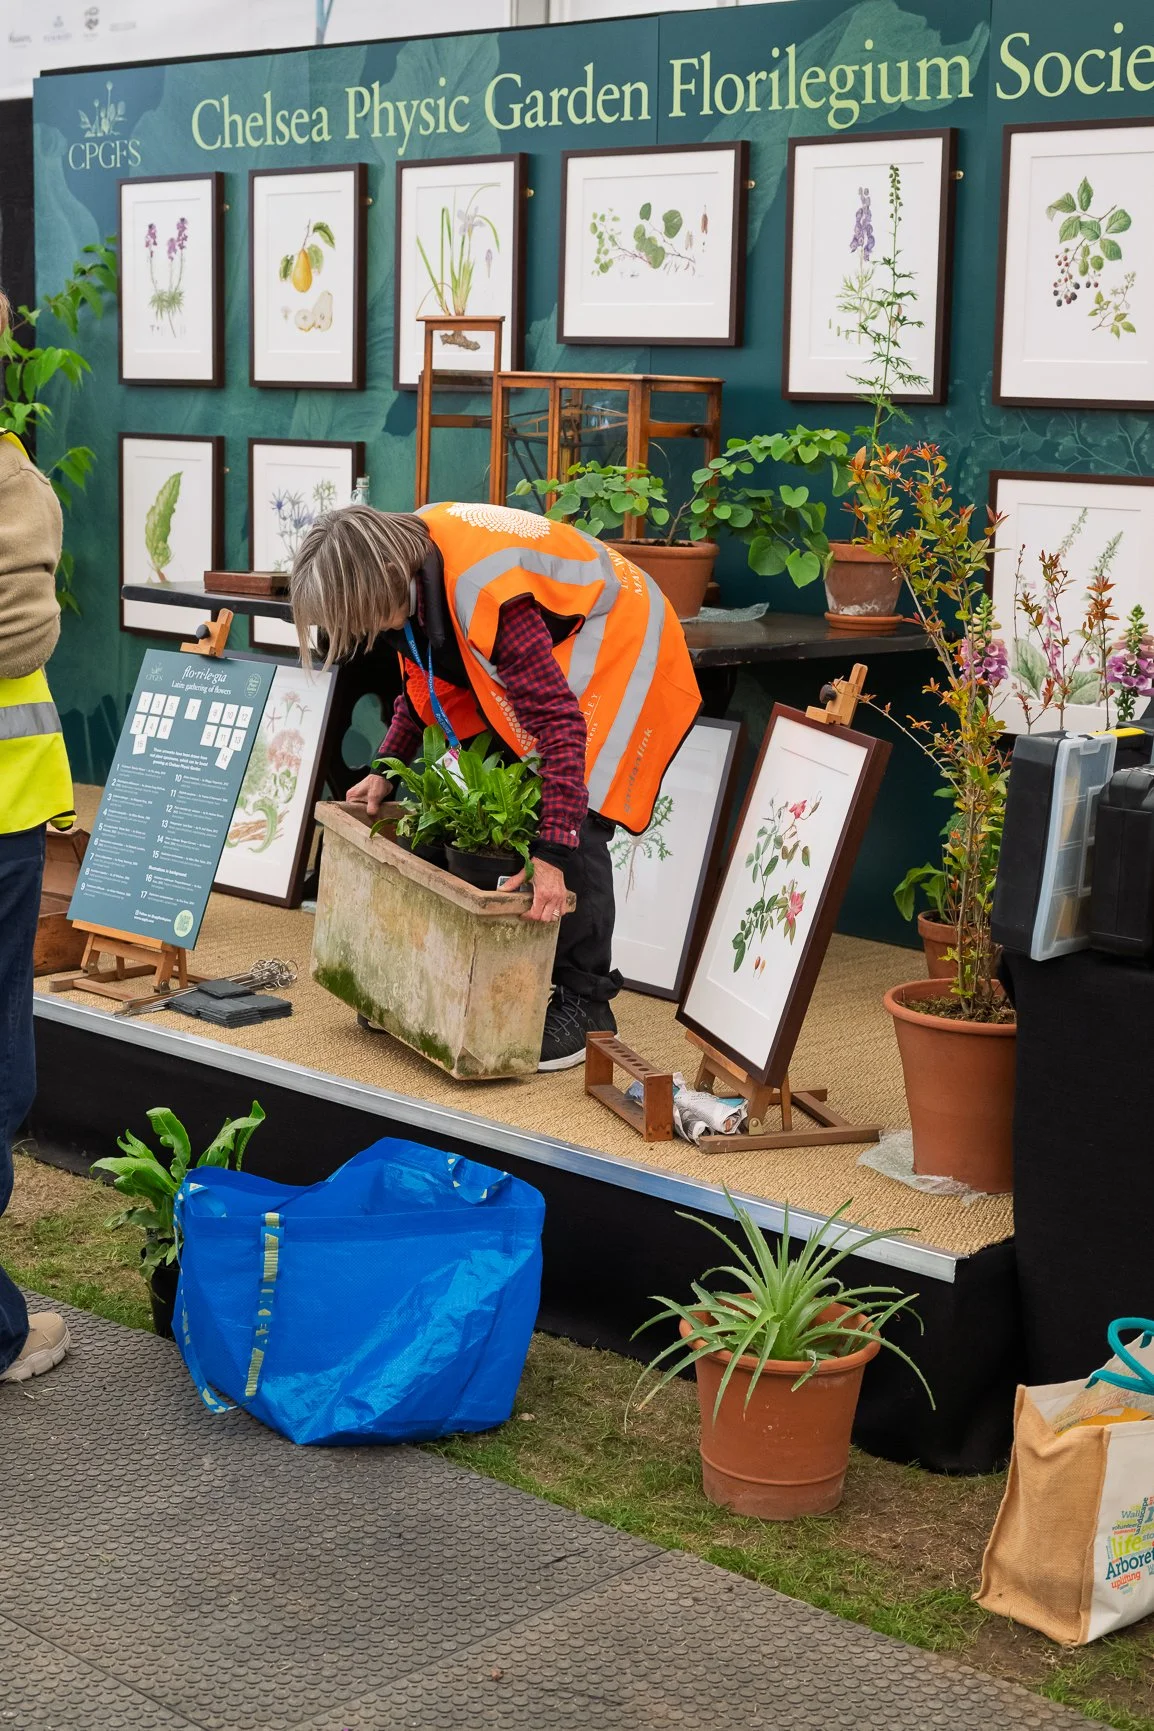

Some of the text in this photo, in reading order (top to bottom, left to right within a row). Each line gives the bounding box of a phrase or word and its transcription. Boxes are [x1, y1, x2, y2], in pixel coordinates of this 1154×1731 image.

[192, 22, 1154, 156] Chelsea Physic Garden Florilegium Socie
[68, 139, 142, 170] CPGFS
[185, 682, 207, 692] gathering
[1110, 1534, 1143, 1558] life
[1110, 1571, 1141, 1590] uplifting
